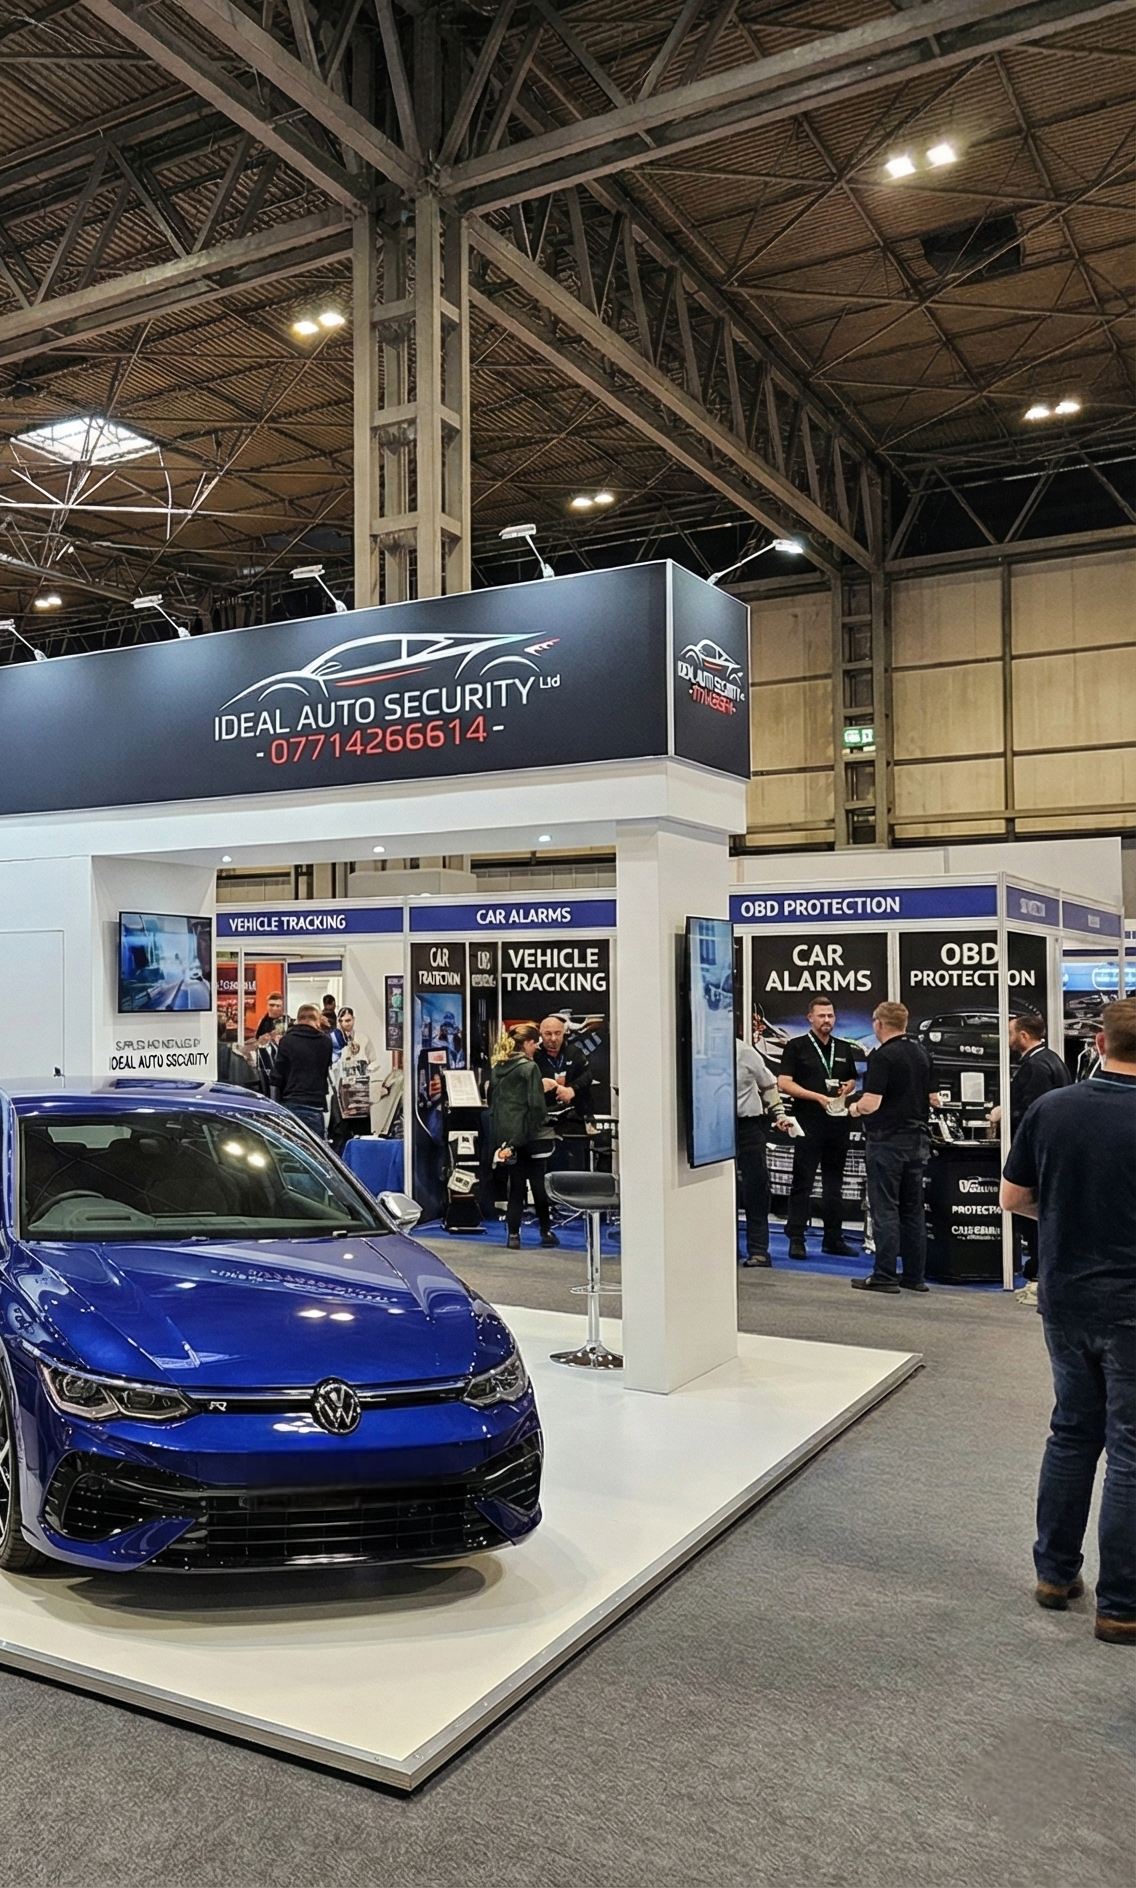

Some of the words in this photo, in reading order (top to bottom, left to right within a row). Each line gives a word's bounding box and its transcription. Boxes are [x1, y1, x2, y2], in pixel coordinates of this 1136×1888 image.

[214, 709, 291, 742] IDEAL
[296, 697, 375, 730] AUTO
[384, 676, 536, 720] SECURITY
[476, 909, 507, 925] CAR
[508, 907, 572, 924] ALARMS
[740, 900, 779, 918] OBD
[783, 896, 901, 917] PROTECTION
[229, 915, 280, 932] VEHICLE
[281, 914, 346, 931] TRACKING
[508, 948, 600, 969] VEHICLE
[792, 944, 845, 967] CAR
[940, 943, 999, 966] OBD
[501, 972, 607, 991] TRACKING
[765, 970, 873, 993] ALARMS
[910, 969, 1036, 987] PROTECTON
